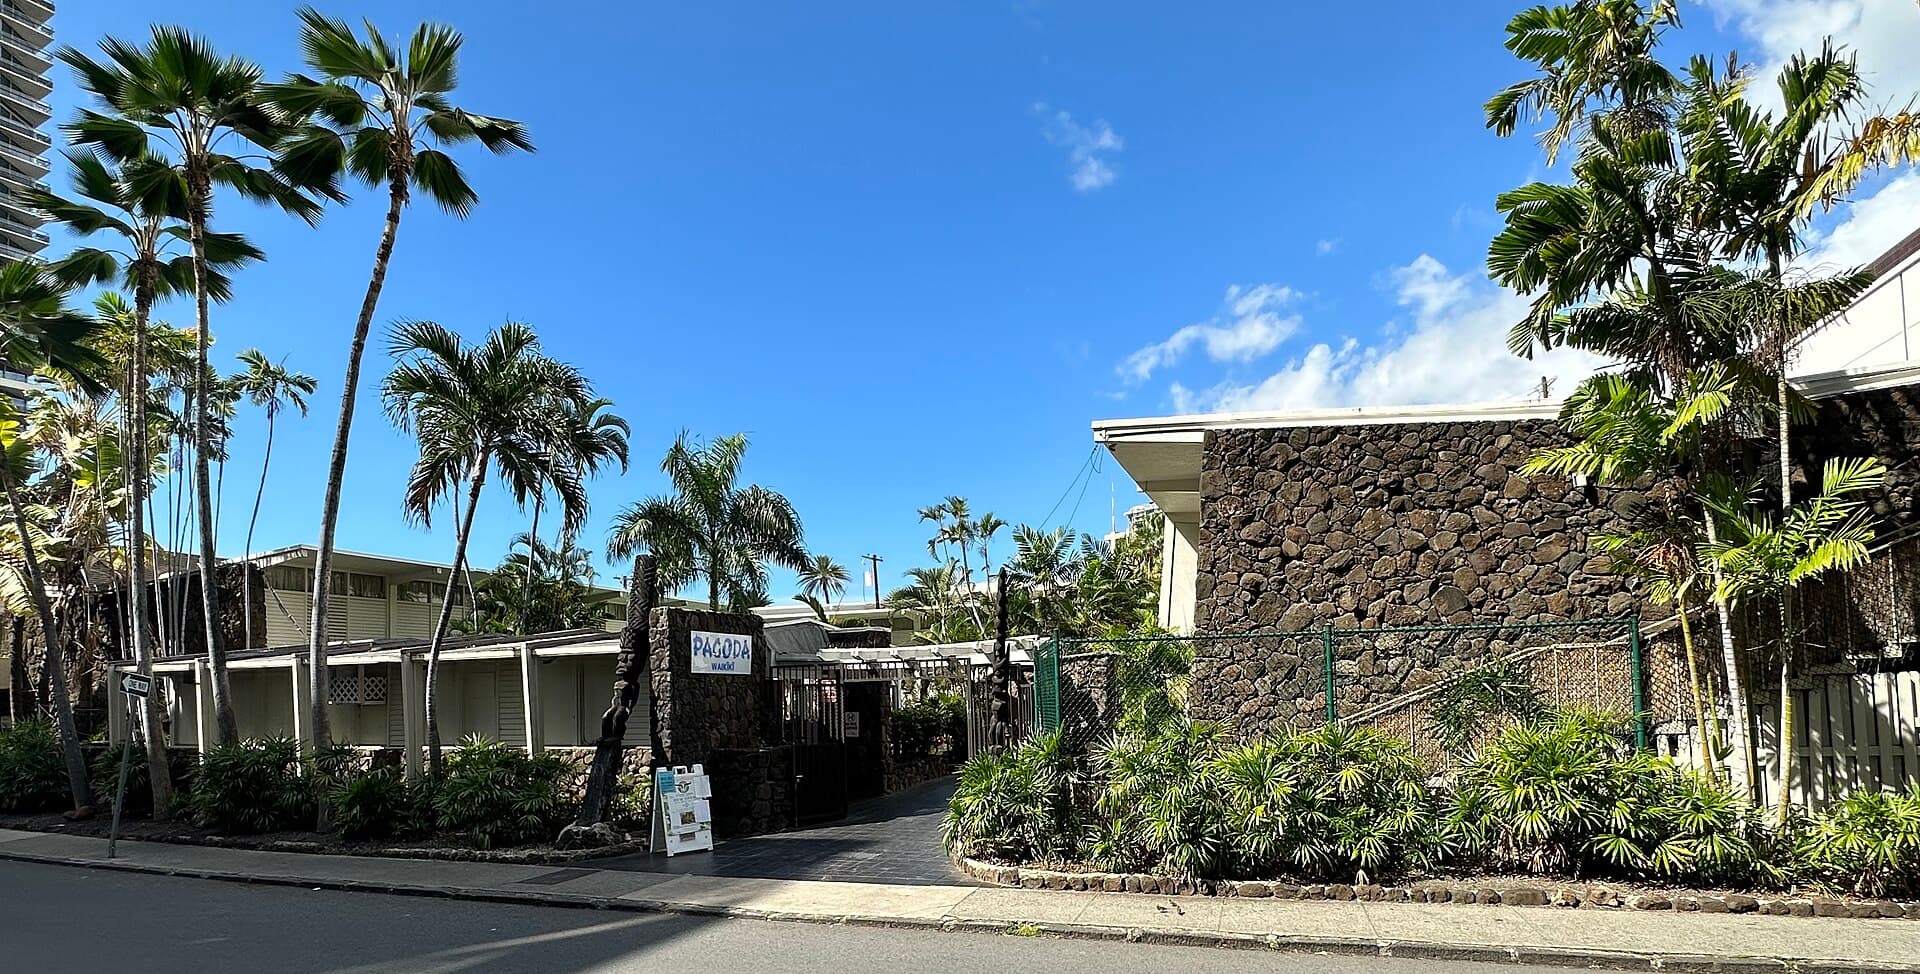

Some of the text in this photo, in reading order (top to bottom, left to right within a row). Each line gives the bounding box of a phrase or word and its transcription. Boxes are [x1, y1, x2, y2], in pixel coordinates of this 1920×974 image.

[693, 635, 750, 660] PAGODA
[128, 680, 147, 690] ONE WAY
